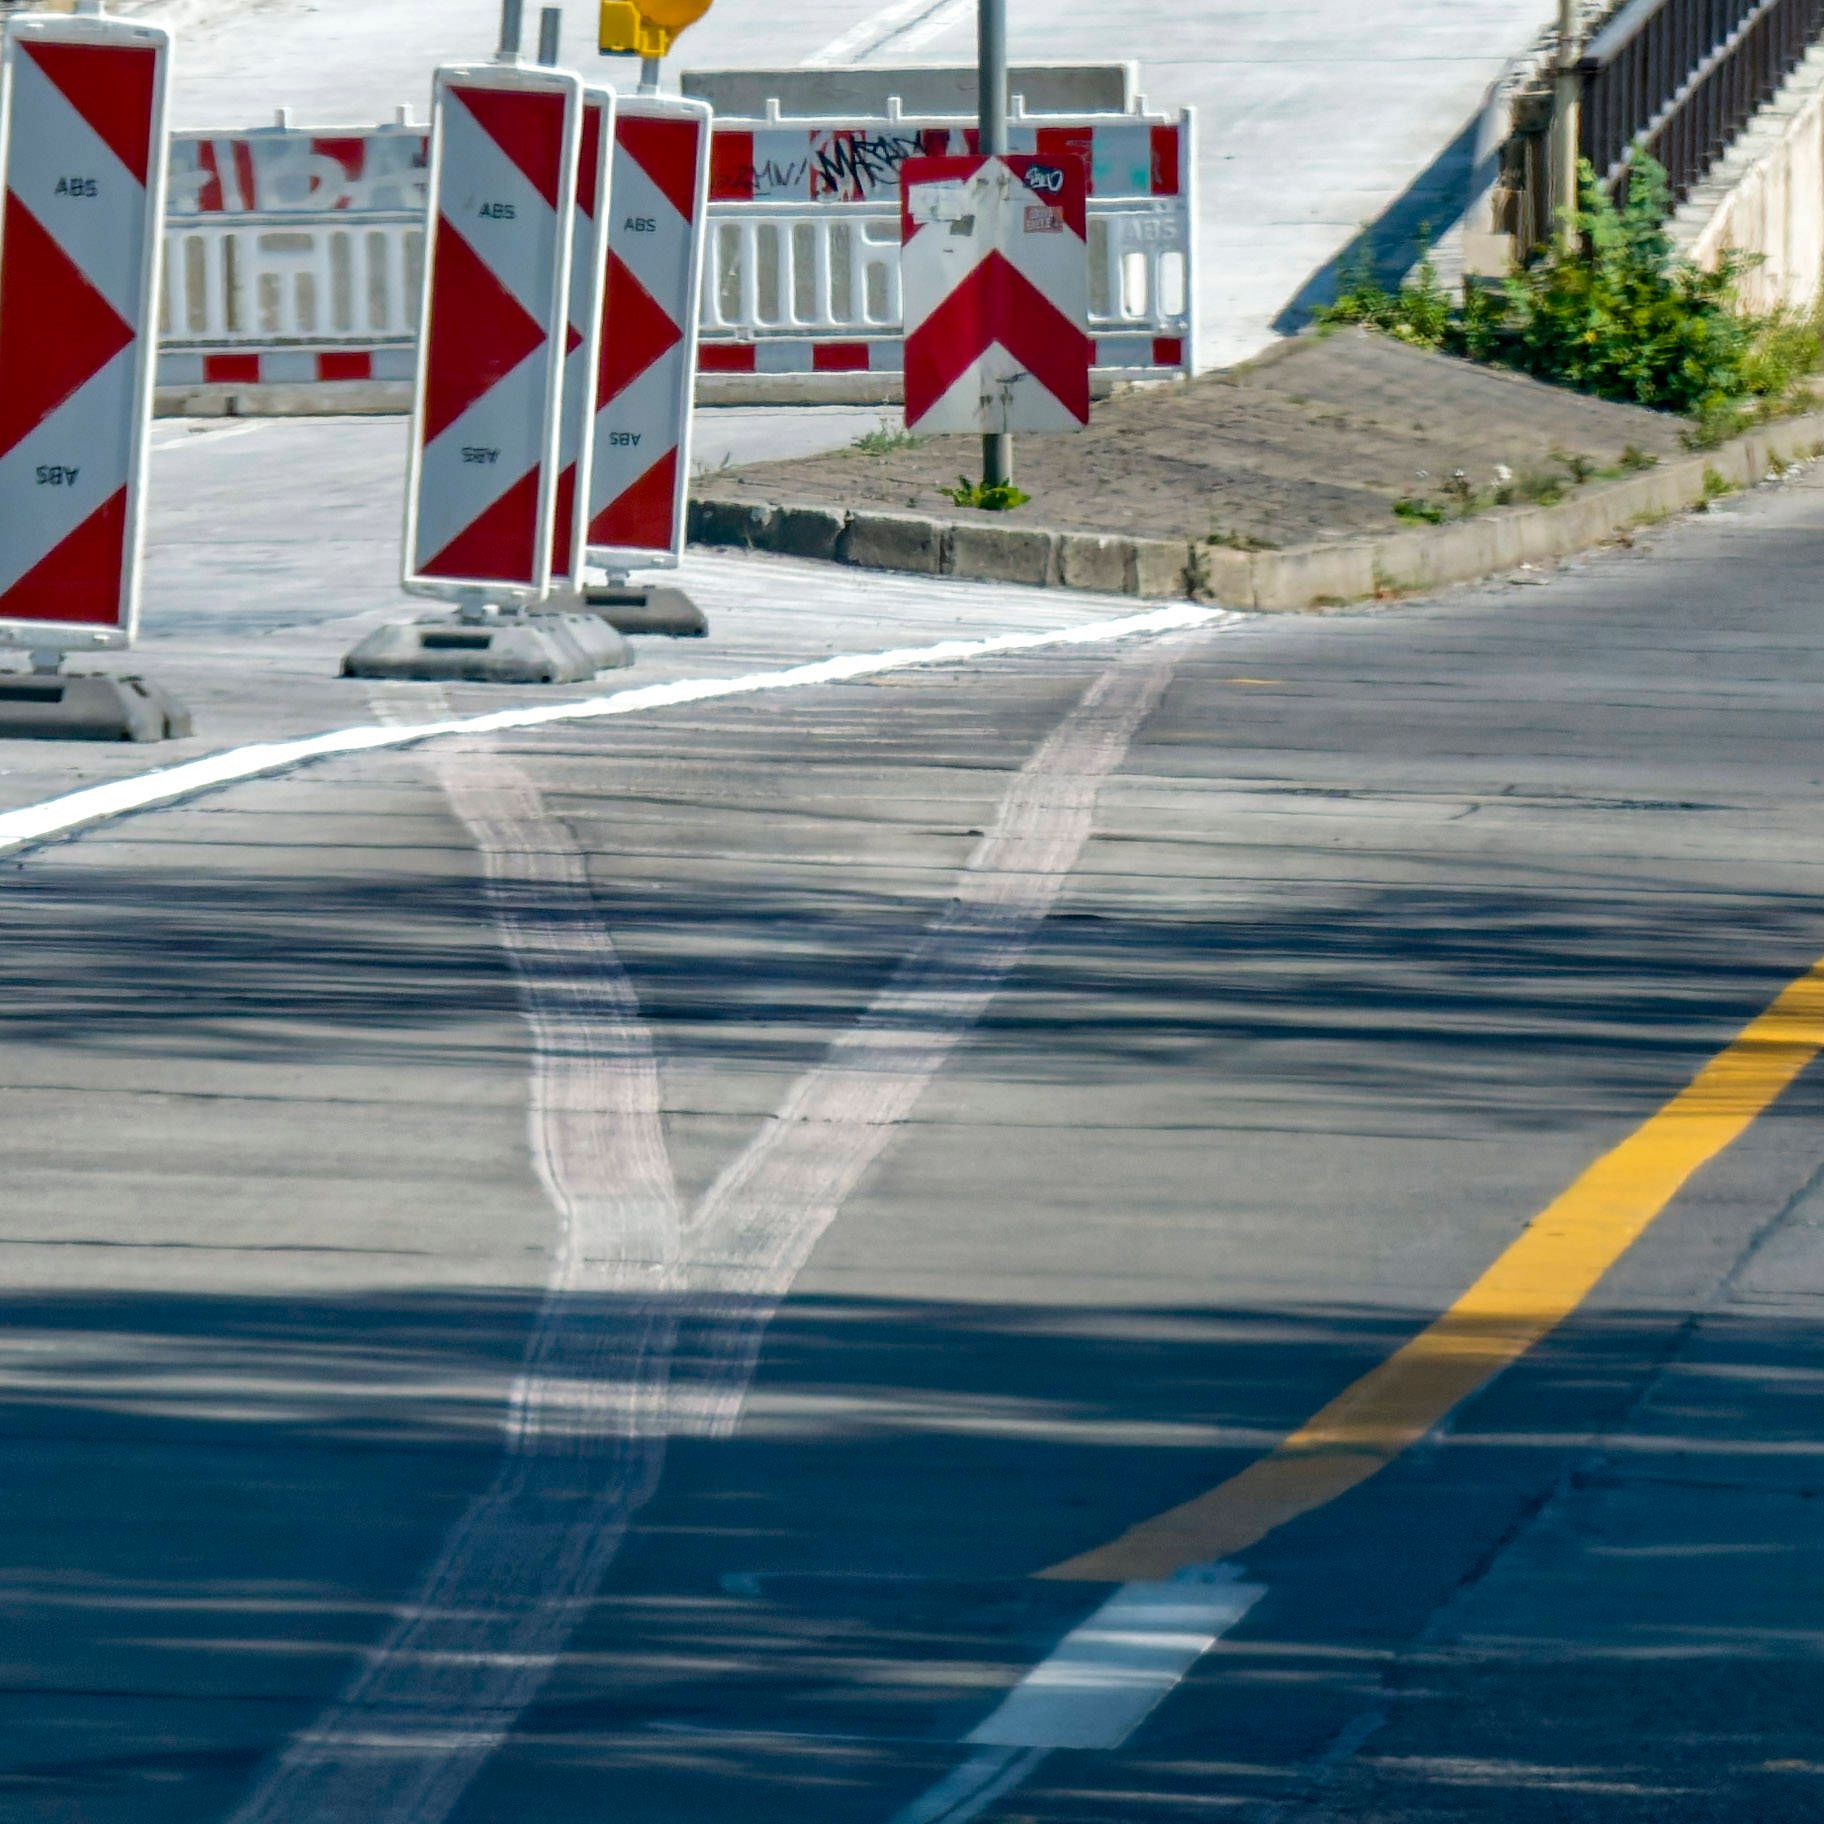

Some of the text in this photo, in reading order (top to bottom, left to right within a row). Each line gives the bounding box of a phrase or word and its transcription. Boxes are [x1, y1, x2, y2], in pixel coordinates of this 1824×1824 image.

[53, 177, 99, 198] ABS
[477, 202, 517, 220] ABS
[622, 217, 658, 233] ABS
[608, 431, 642, 447] ABS
[461, 446, 500, 464] ABS
[35, 463, 80, 487] ABS
